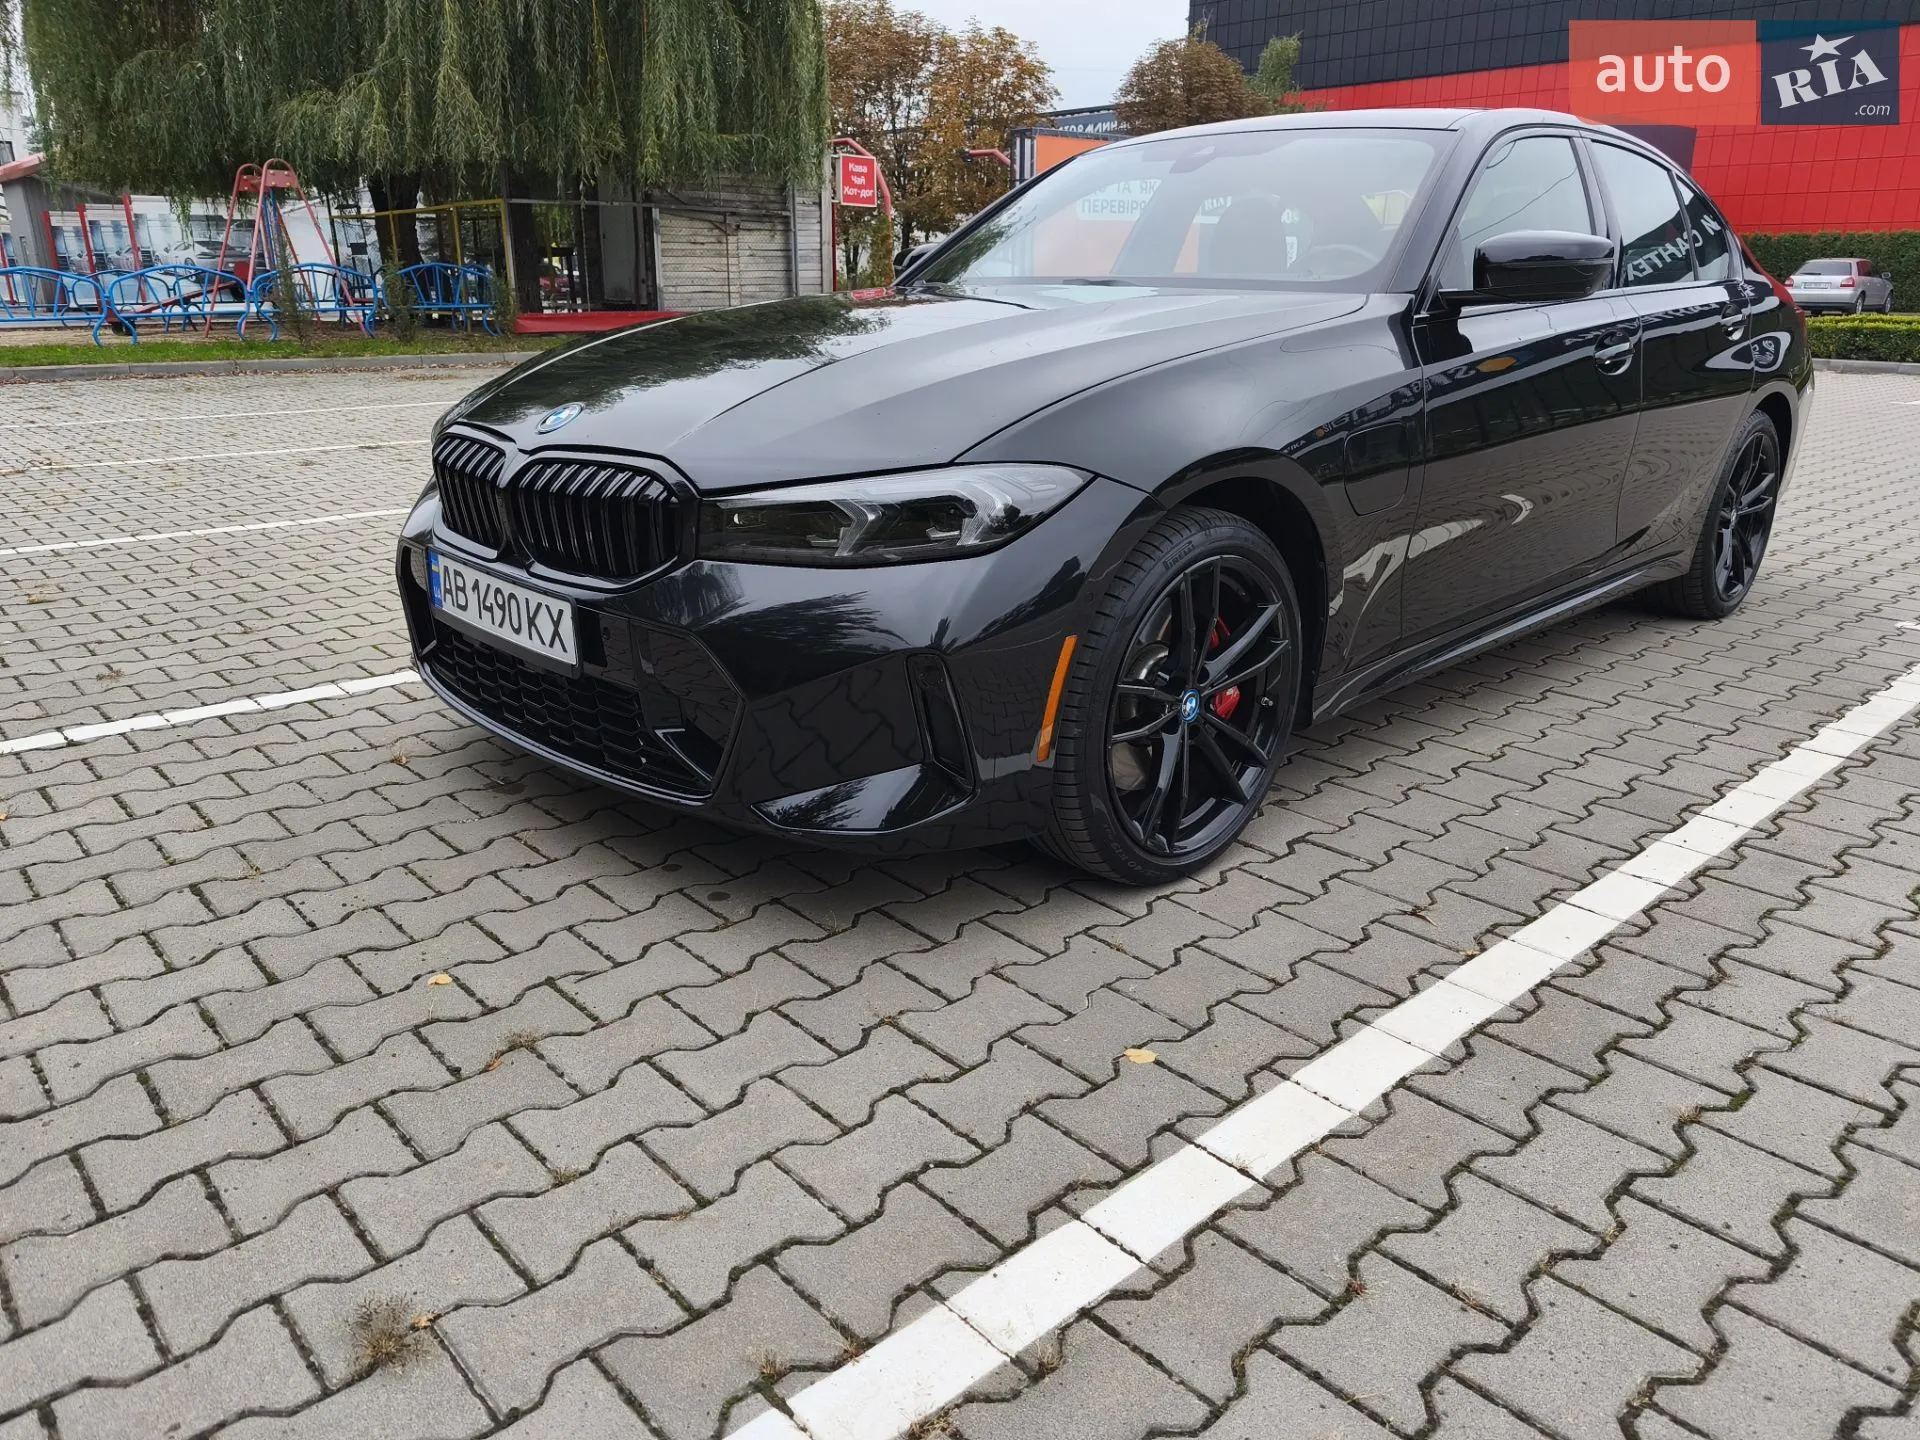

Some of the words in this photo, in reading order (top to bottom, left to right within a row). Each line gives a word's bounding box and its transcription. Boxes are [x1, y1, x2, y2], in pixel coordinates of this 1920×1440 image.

[848, 162, 868, 173] Кава
[851, 175, 866, 185] Чай
[843, 185, 874, 199] Хот-дог
